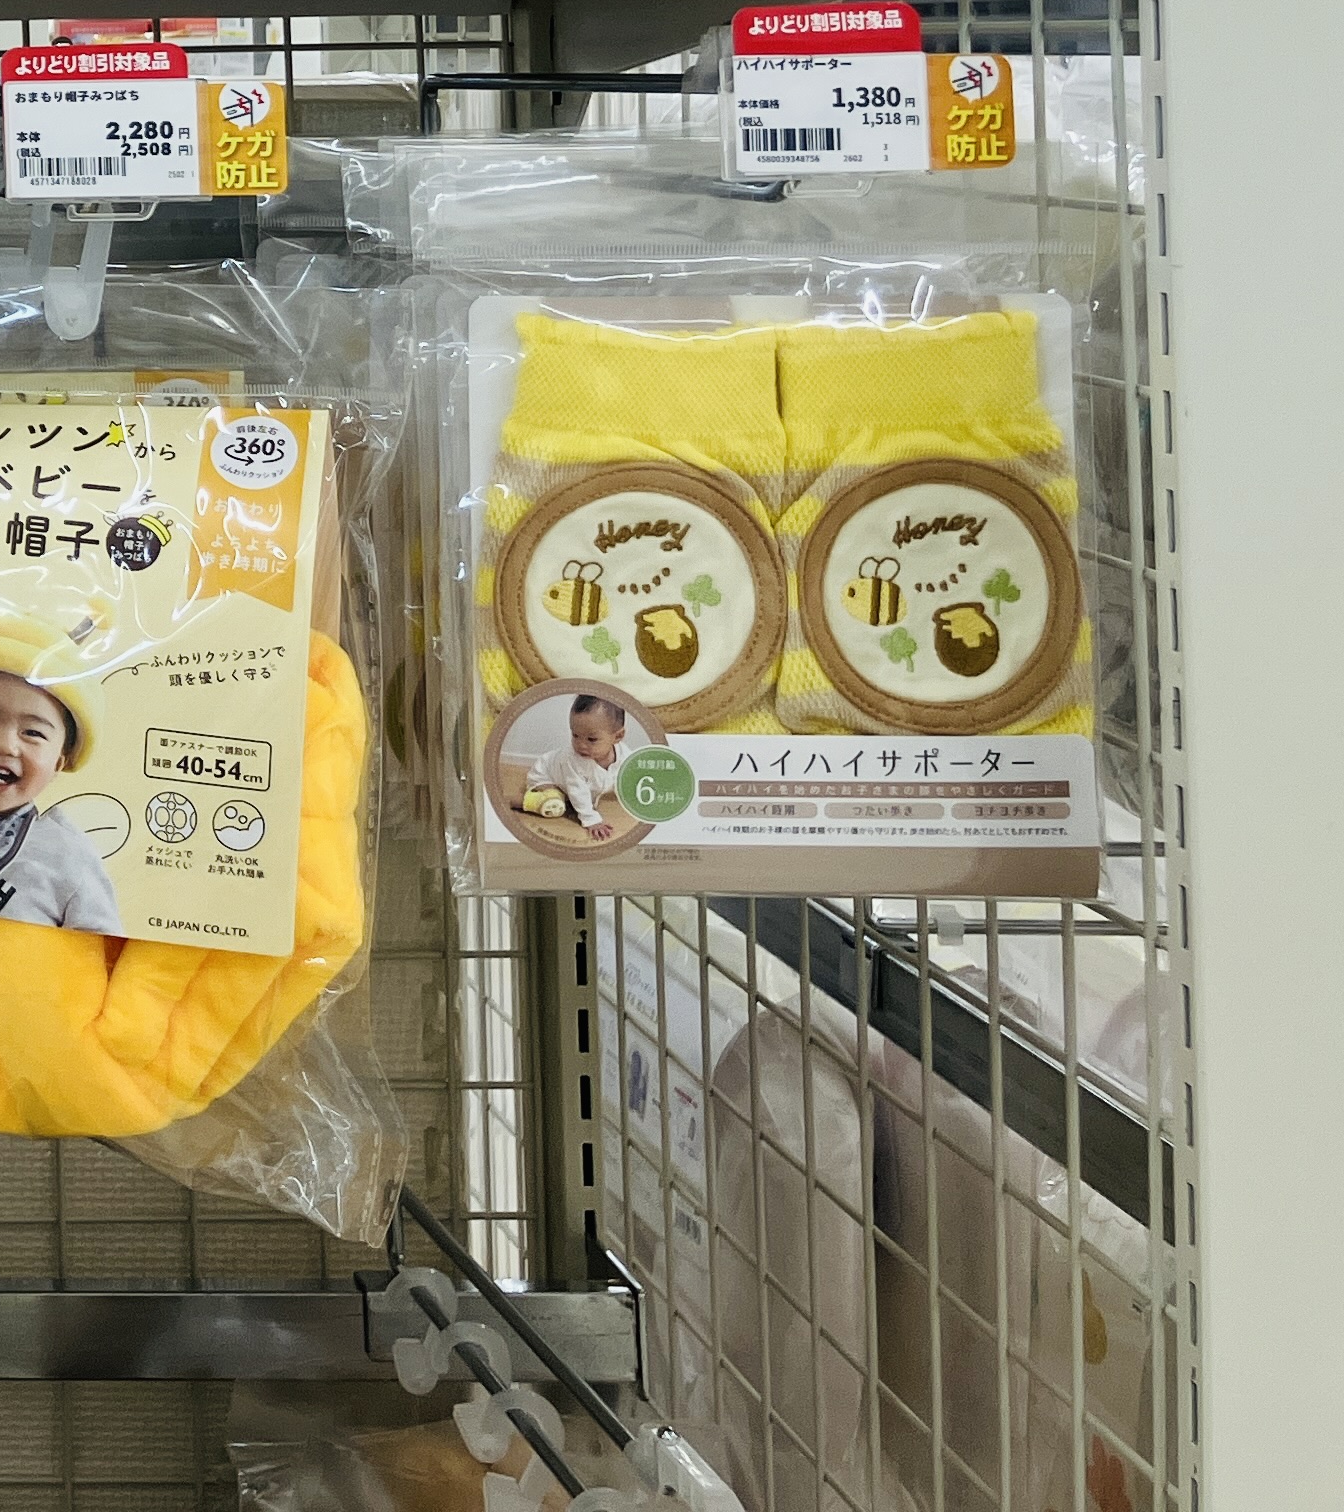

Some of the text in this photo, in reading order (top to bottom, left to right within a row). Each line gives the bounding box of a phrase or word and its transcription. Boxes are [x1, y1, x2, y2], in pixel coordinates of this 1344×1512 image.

[749, 10, 903, 36] よりどり割引対象品
[15, 52, 170, 76] よりどり割引対象品
[737, 59, 852, 70] ハイハイサポーター
[15, 90, 140, 104] おまもり帽子みつばち
[832, 87, 900, 112] 1,380
[862, 113, 901, 126] 1,518
[948, 105, 1004, 130] ケガ
[16, 121, 174, 142] 本体 2,280
[121, 143, 171, 157] 2,508
[217, 132, 274, 157] ケガ
[947, 135, 1008, 162] 防止
[216, 162, 279, 188] 防止
[595, 519, 691, 553] Honey
[893, 517, 987, 549] Honey
[151, 645, 286, 669] ふんわりクッションで
[169, 667, 272, 688] 頭を優しく守る
[177, 756, 241, 780] 40-54
[731, 748, 1036, 778] ハイハイサポーター
[146, 846, 193, 858] メッシュで
[148, 917, 163, 928] CB
[166, 919, 200, 933] JAPAN
